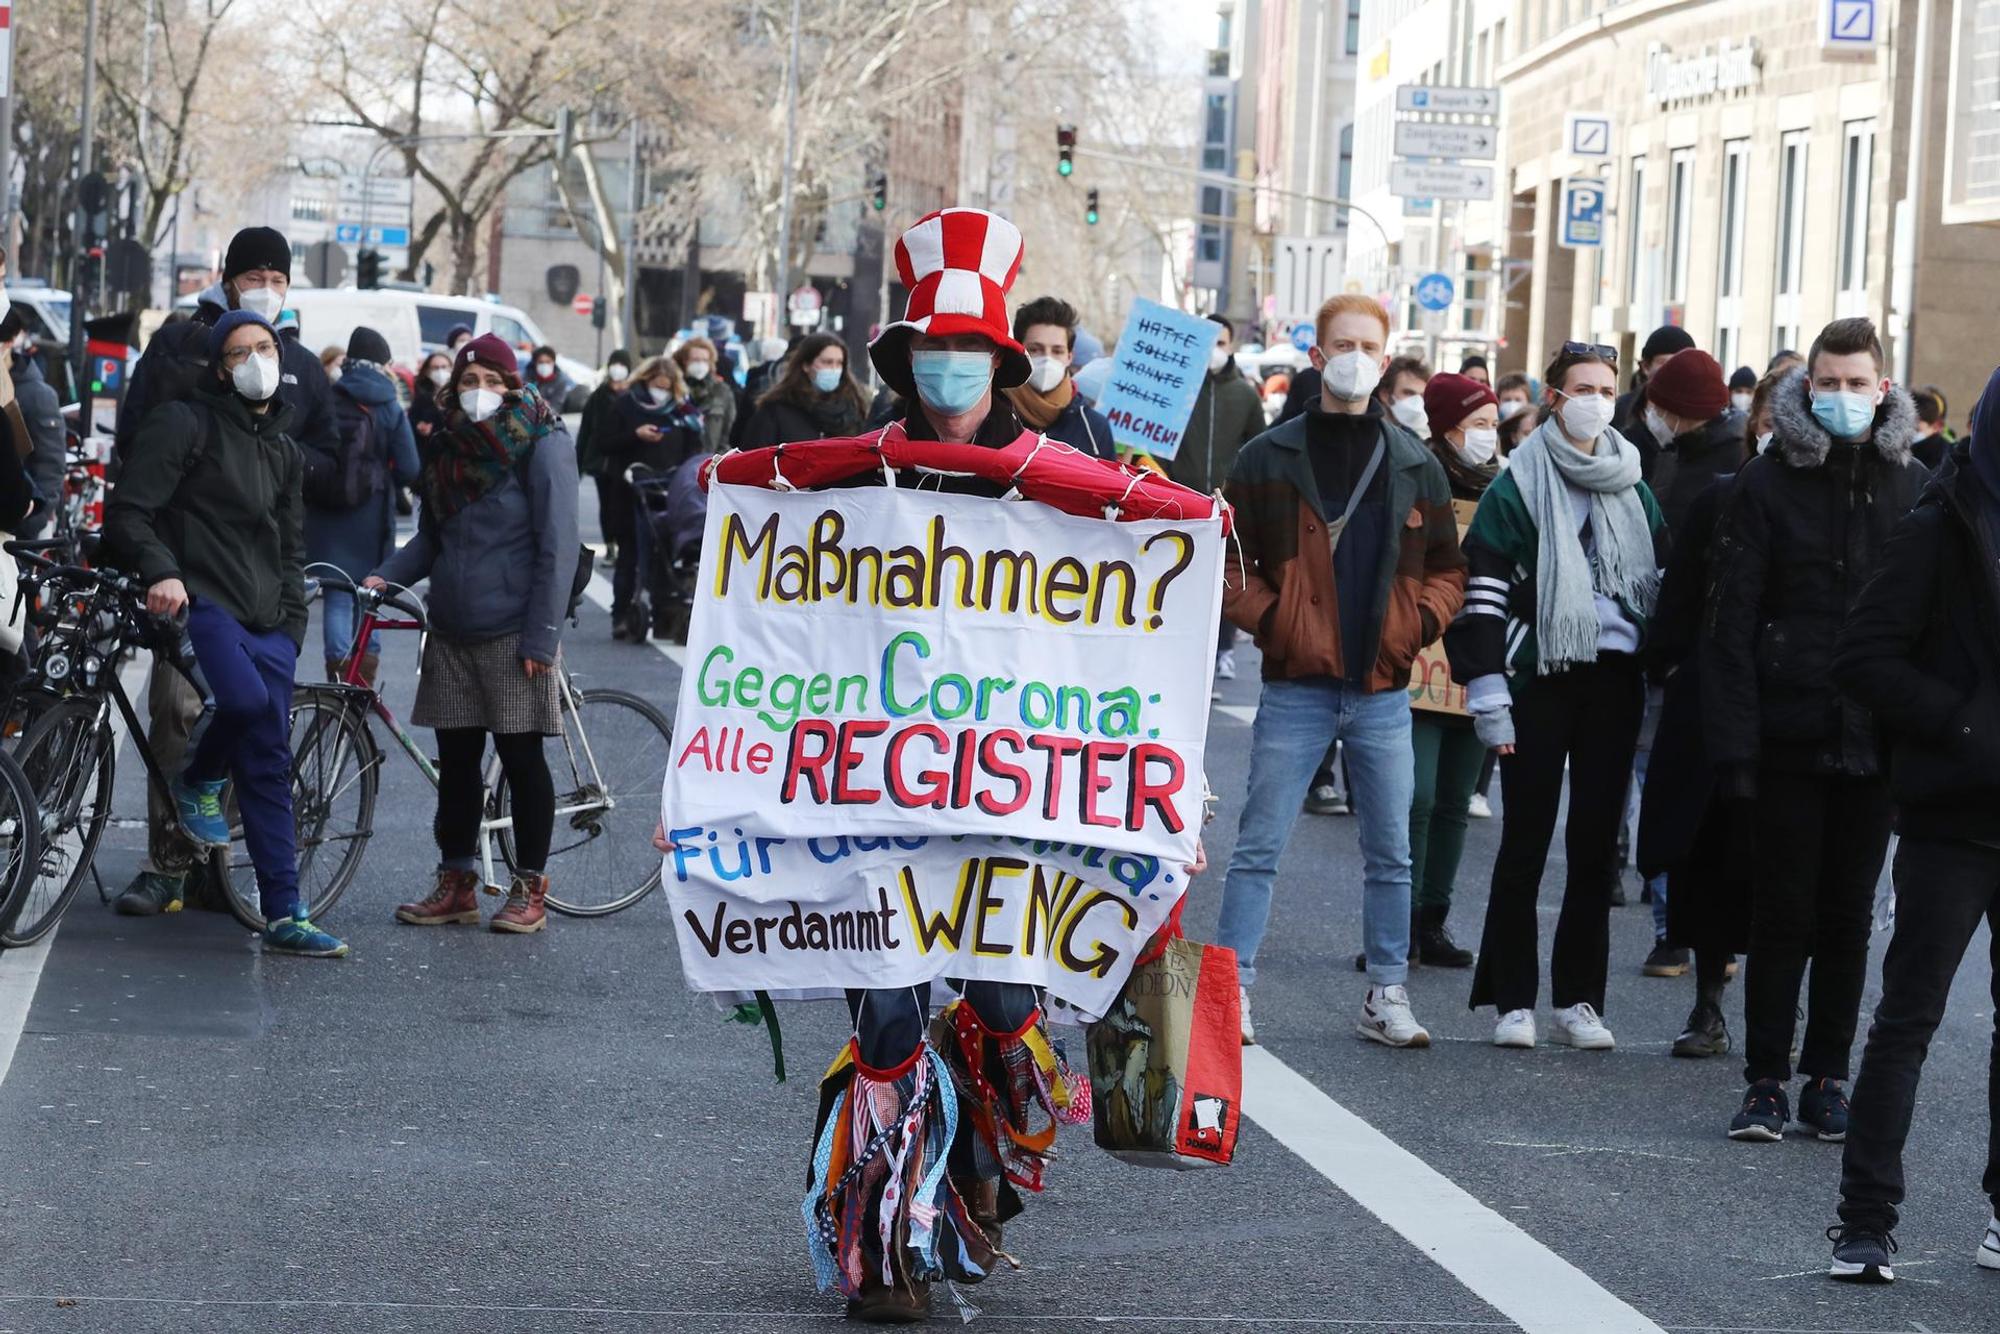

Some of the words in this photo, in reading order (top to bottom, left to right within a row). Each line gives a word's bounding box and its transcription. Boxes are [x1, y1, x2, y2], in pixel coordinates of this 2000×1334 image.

[1572, 188, 1597, 217] P
[1107, 407, 1179, 447] MACHEN!
[714, 508, 1195, 632] Maßnahmen?
[699, 644, 868, 732] Gegen
[881, 631, 1162, 739] Corona:
[677, 726, 774, 776] Alle
[779, 719, 1186, 834] REGISTER
[669, 826, 786, 882] Für
[684, 886, 900, 958] Verdammt
